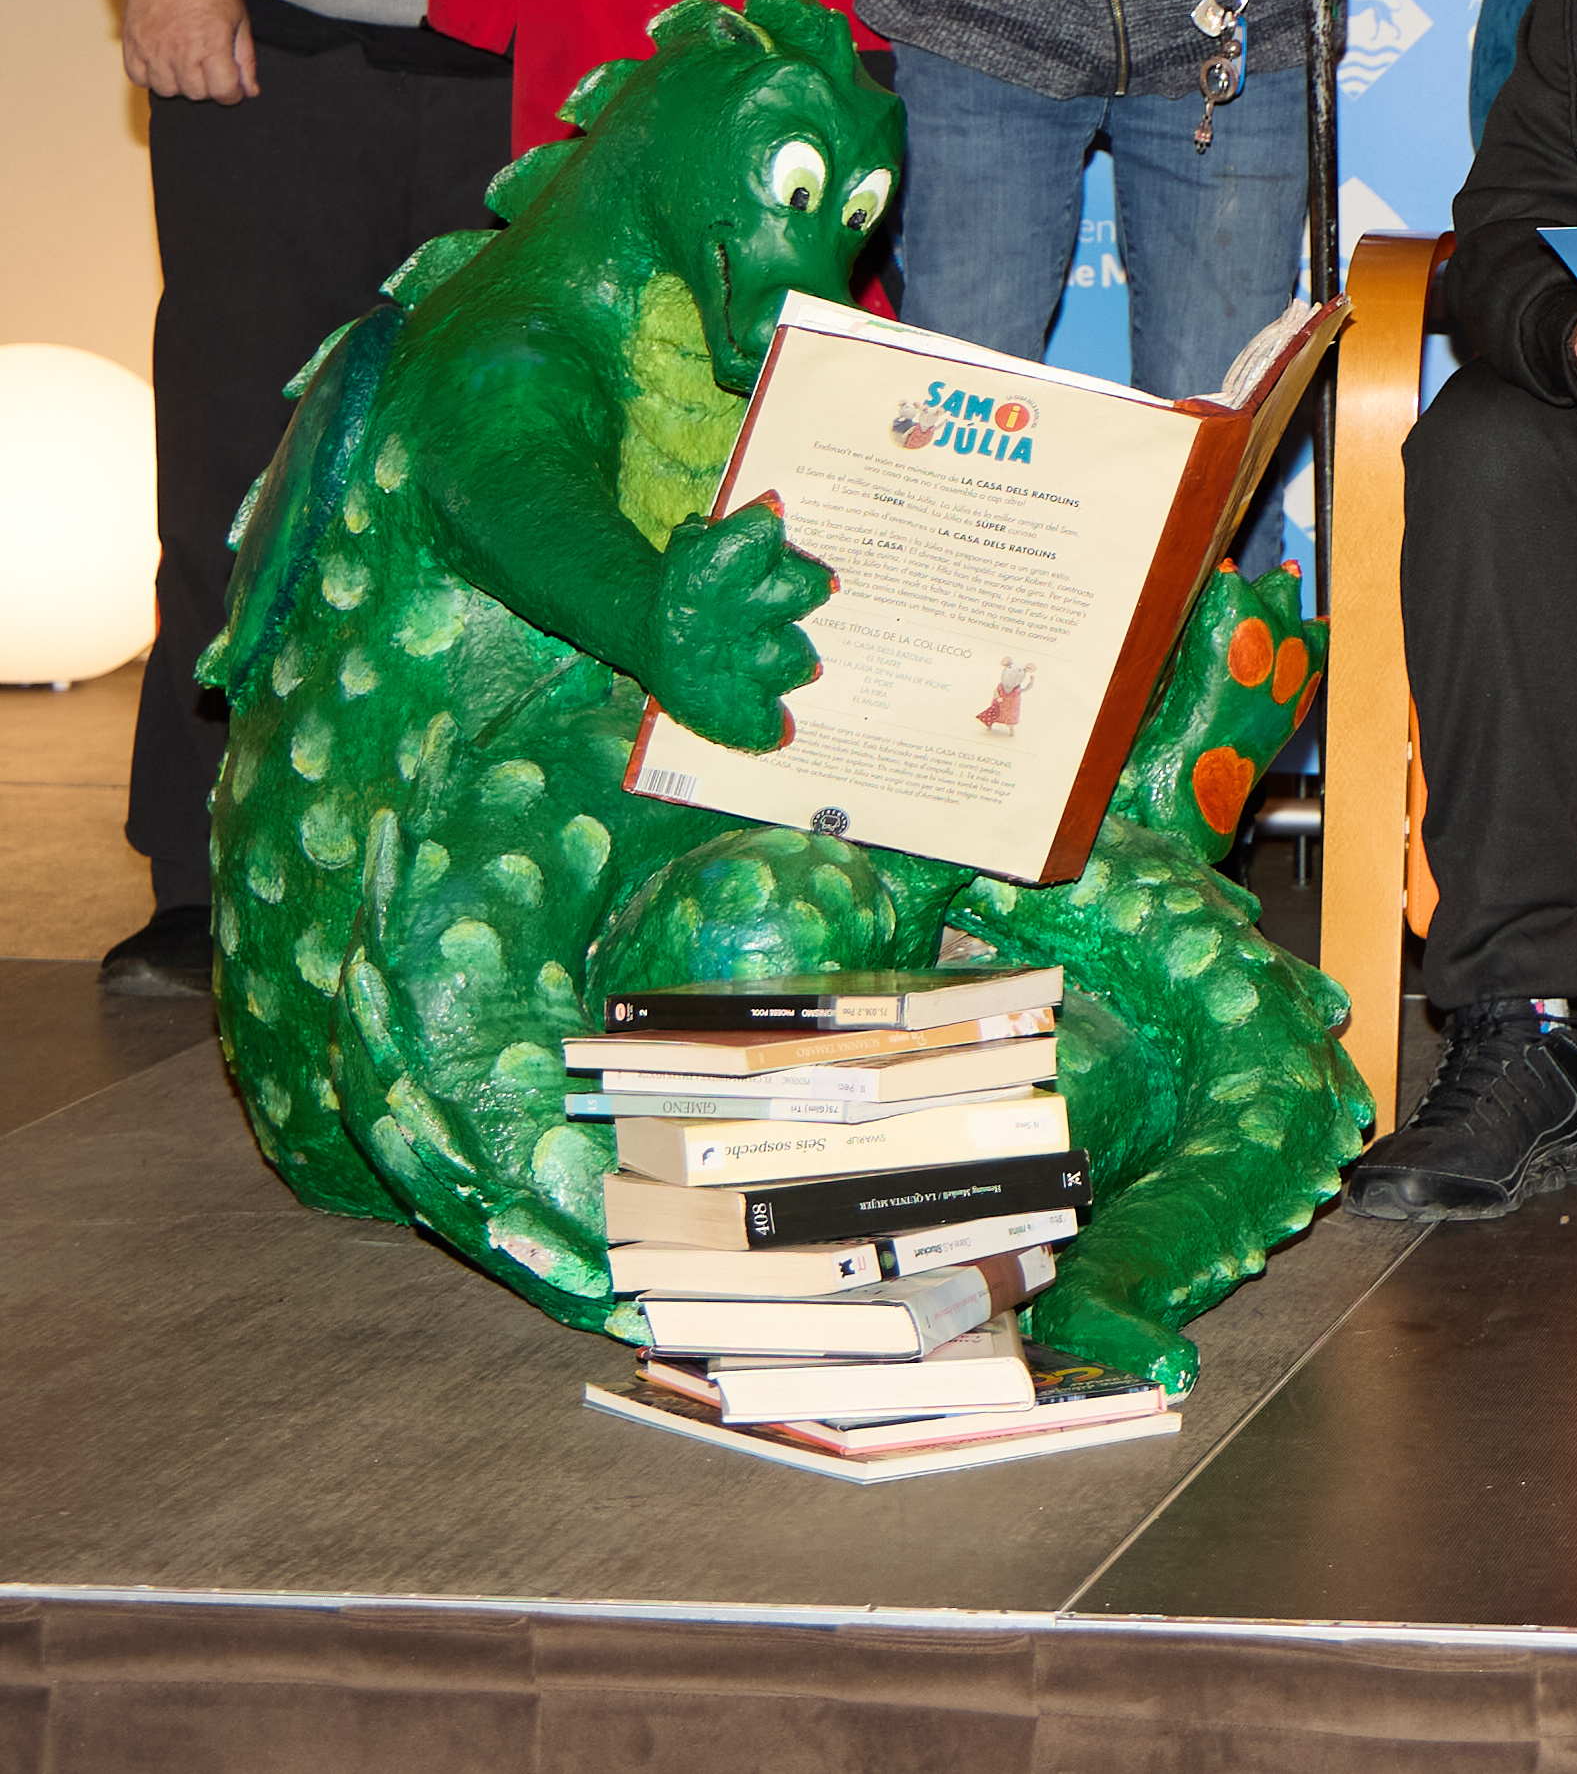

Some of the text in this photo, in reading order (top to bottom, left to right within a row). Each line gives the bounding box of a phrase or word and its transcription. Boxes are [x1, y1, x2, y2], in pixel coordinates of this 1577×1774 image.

[927, 380, 995, 423] SAM
[932, 420, 1035, 465] JÚLIA
[960, 476, 974, 486] LA
[975, 478, 1003, 492] CASA
[1004, 484, 1029, 497] DELS
[872, 490, 906, 507] SÚPER
[974, 517, 1007, 533] SÚPER
[861, 536, 874, 546] LA
[937, 527, 951, 537] LA
[952, 531, 981, 544] CASA
[982, 538, 1006, 550] DELS
[811, 615, 847, 631] ALTRES
[848, 622, 881, 638] TÍTOLS
[882, 631, 897, 641] DE
[898, 634, 911, 644] LA
[796, 1035, 882, 1059] SUSANNA TAMARO
[662, 1100, 717, 1115] GIMENO
[796, 1137, 827, 1153] Seis
[846, 1134, 887, 1145] SWARUP
[858, 1198, 890, 1211] MUJER
[890, 1194, 923, 1206] QUINTA
[751, 1201, 770, 1236] 408
